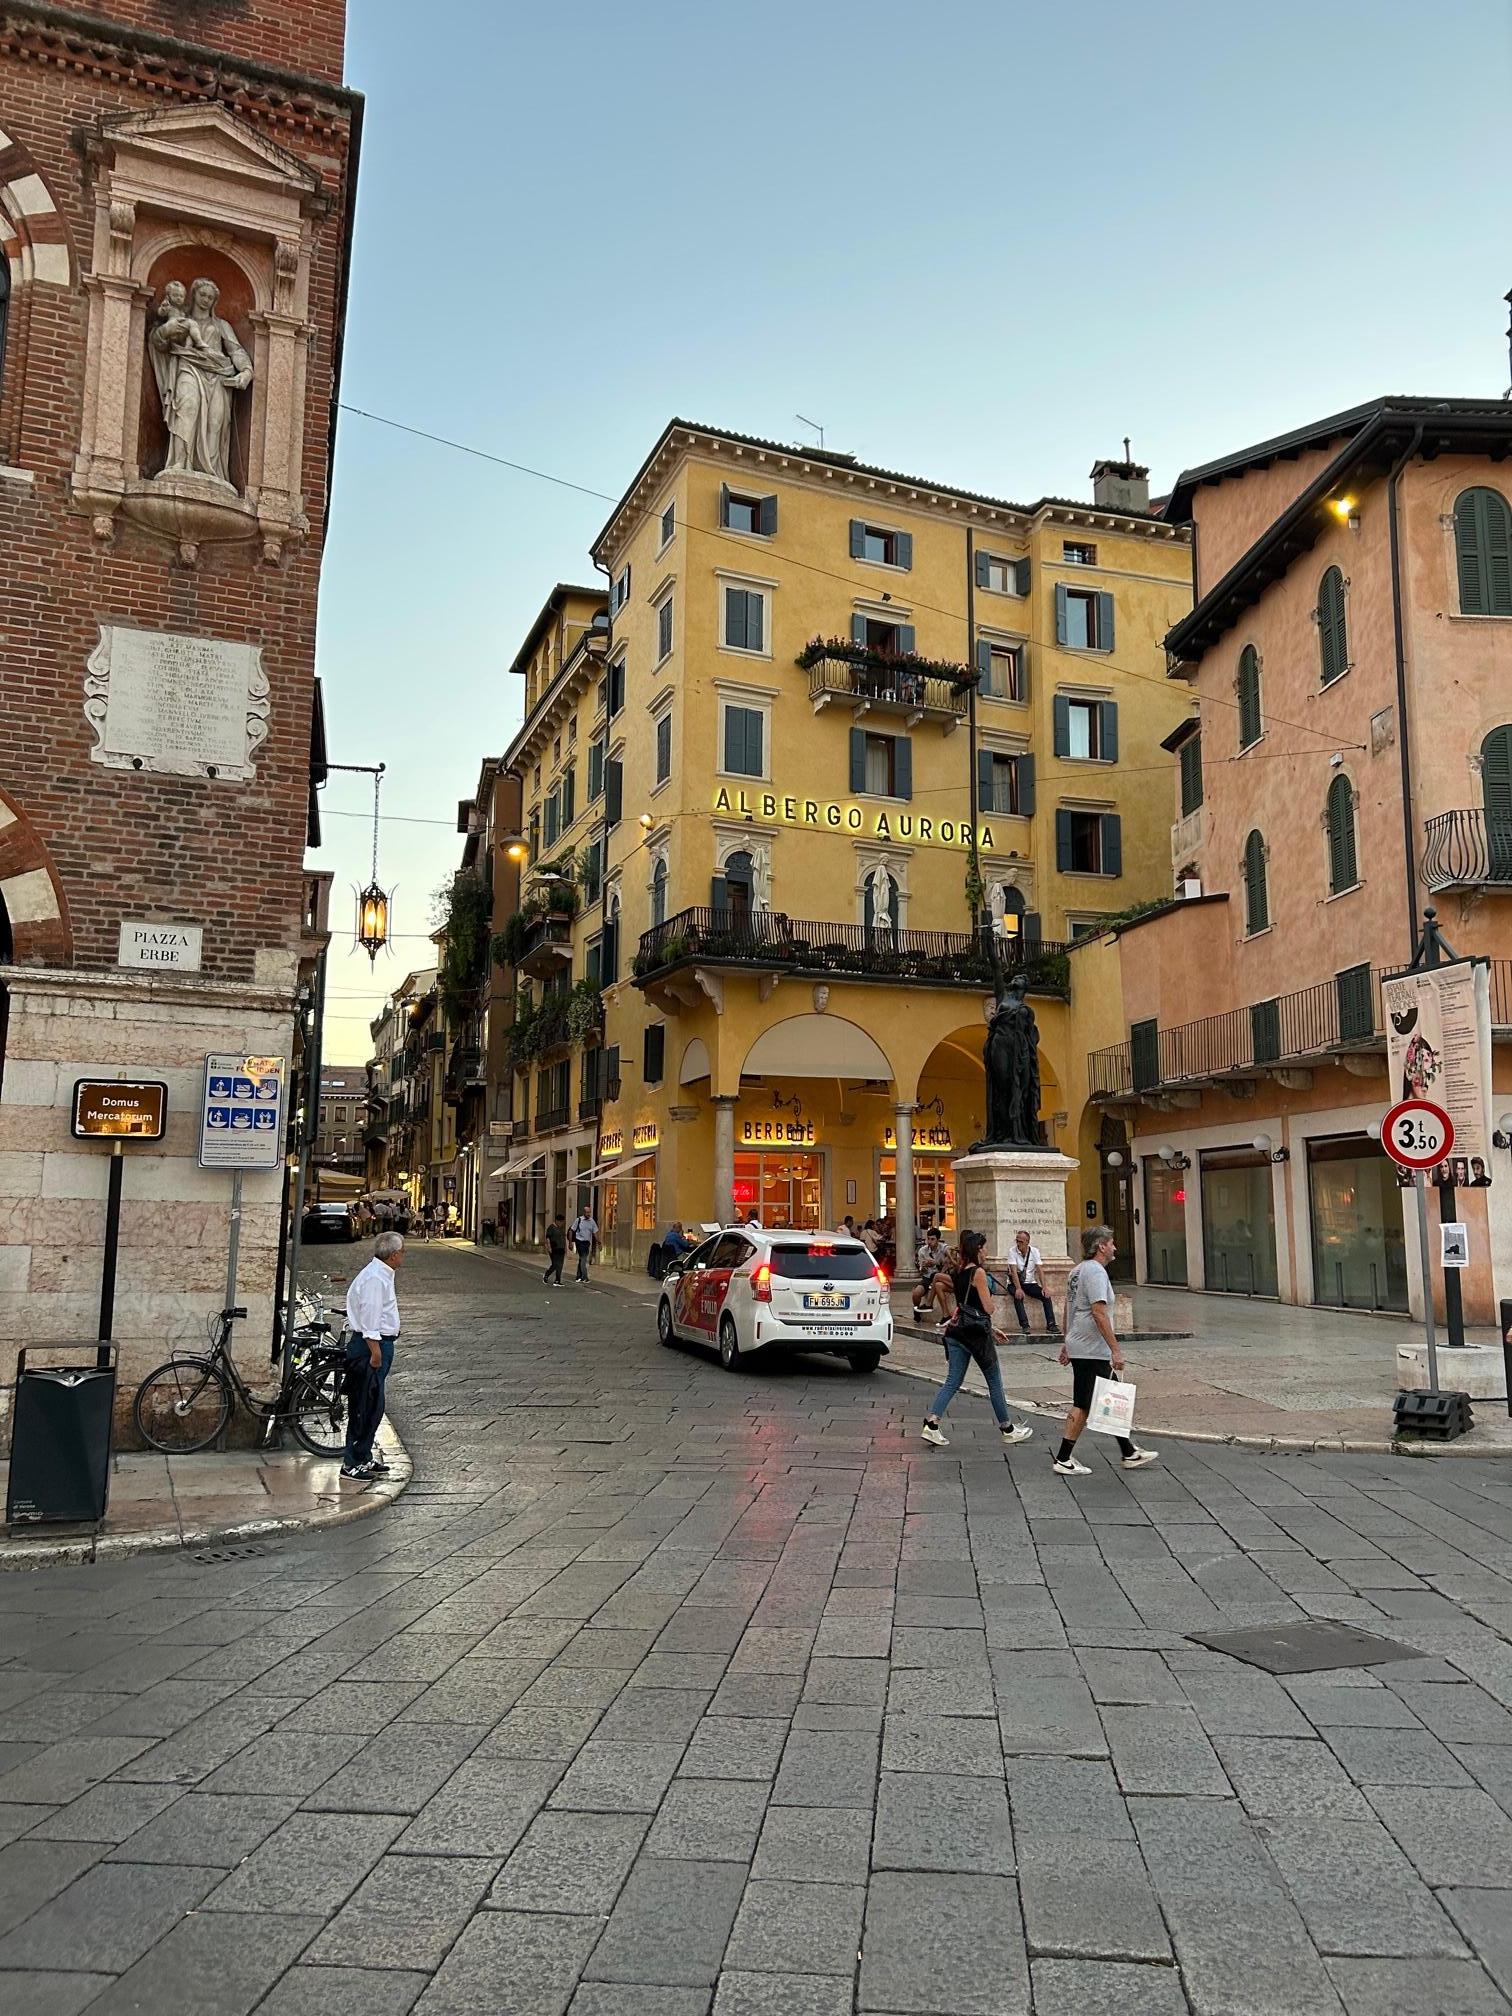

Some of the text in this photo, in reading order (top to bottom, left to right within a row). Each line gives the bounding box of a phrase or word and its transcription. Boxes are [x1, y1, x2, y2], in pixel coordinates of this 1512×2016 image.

[716, 787, 994, 847] ALBERGO AURORA
[134, 931, 189, 946] PIAZZA
[140, 948, 179, 962] ERBE
[102, 1097, 139, 1107] Domus
[87, 1110, 152, 1122] Mercatorum
